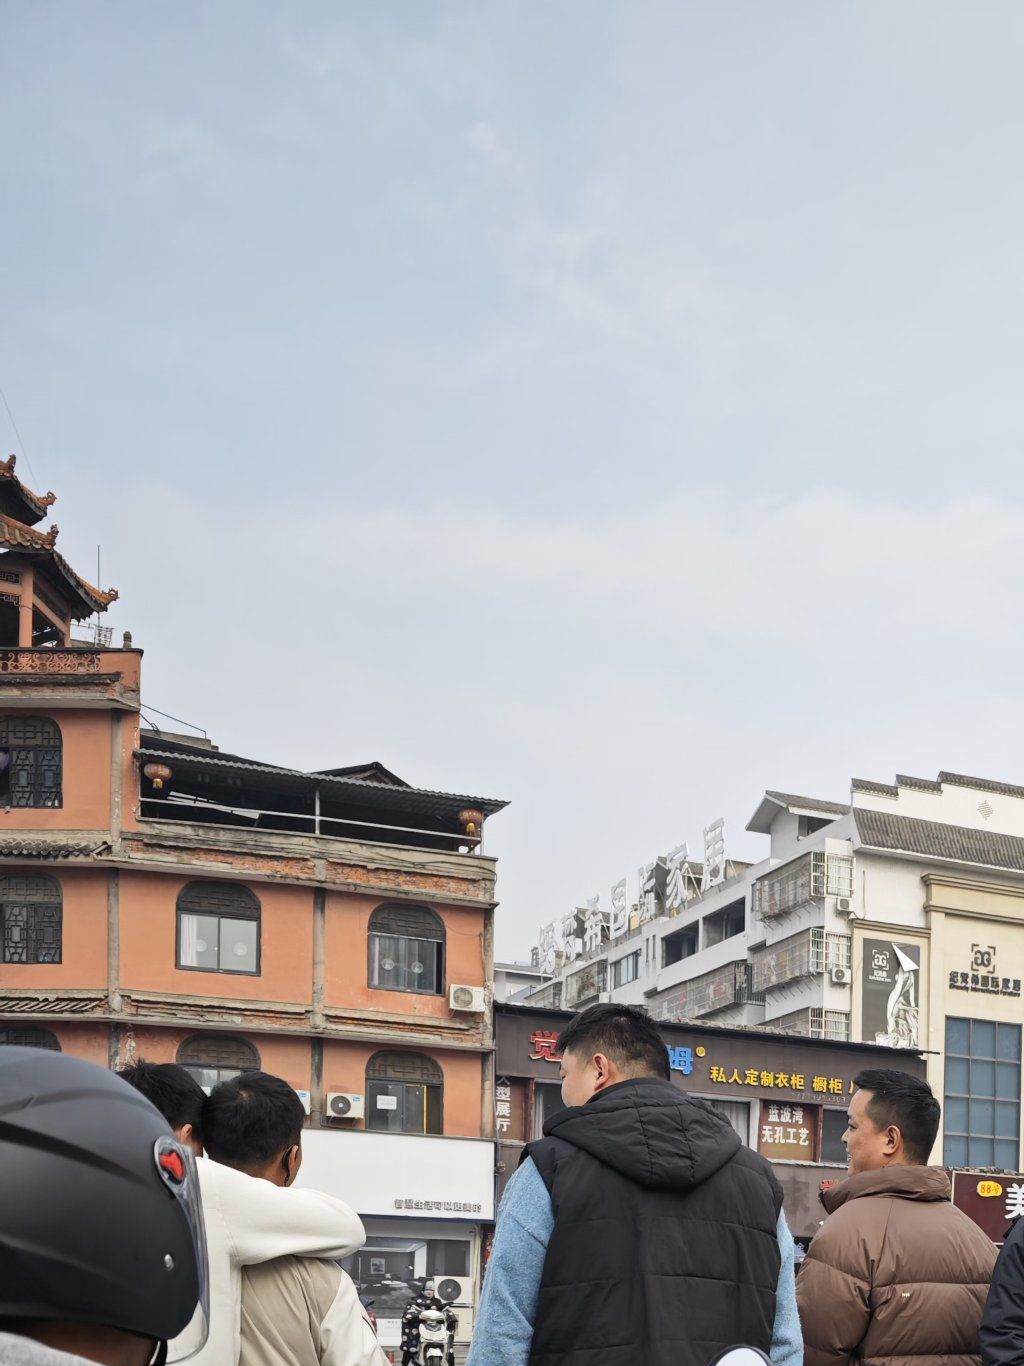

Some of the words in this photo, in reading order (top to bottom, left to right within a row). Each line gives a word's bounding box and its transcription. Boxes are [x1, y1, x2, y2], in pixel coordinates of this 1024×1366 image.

[710, 1066, 805, 1090] 私人定制衣柜
[812, 1075, 843, 1094] 橱柜
[767, 1104, 804, 1124] 蓝波湾
[761, 1126, 809, 1146] 无孔工艺
